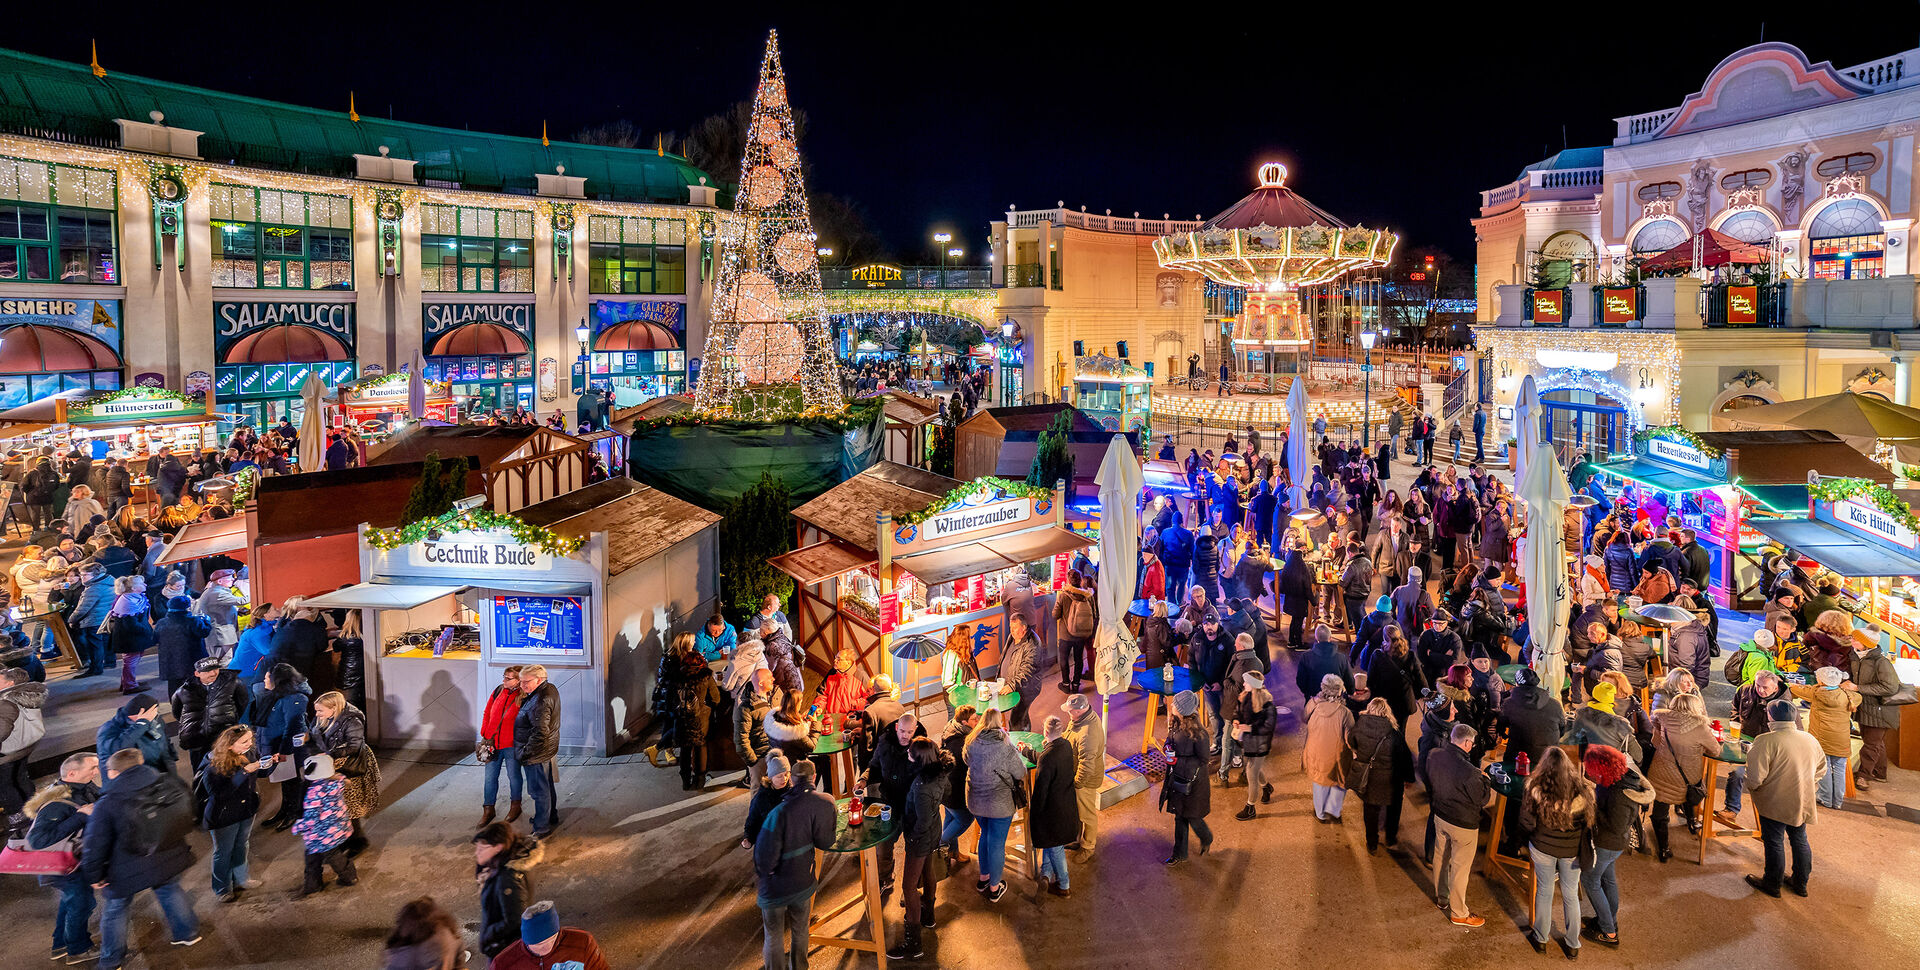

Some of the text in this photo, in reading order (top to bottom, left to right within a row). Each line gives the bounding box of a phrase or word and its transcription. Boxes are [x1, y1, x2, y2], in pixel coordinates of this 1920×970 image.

[851, 265, 902, 280] PRATER
[220, 303, 350, 336] SALAMUCCI
[427, 305, 529, 333] SALAMUCCI
[216, 372, 235, 389] PIZZA
[105, 402, 173, 413] Hühnerstall
[1657, 442, 1702, 464] Hexenkessel
[934, 507, 1019, 534] Winterzauber
[1850, 506, 1896, 536] Käs Hüttn
[423, 542, 536, 566] Technik Bude
